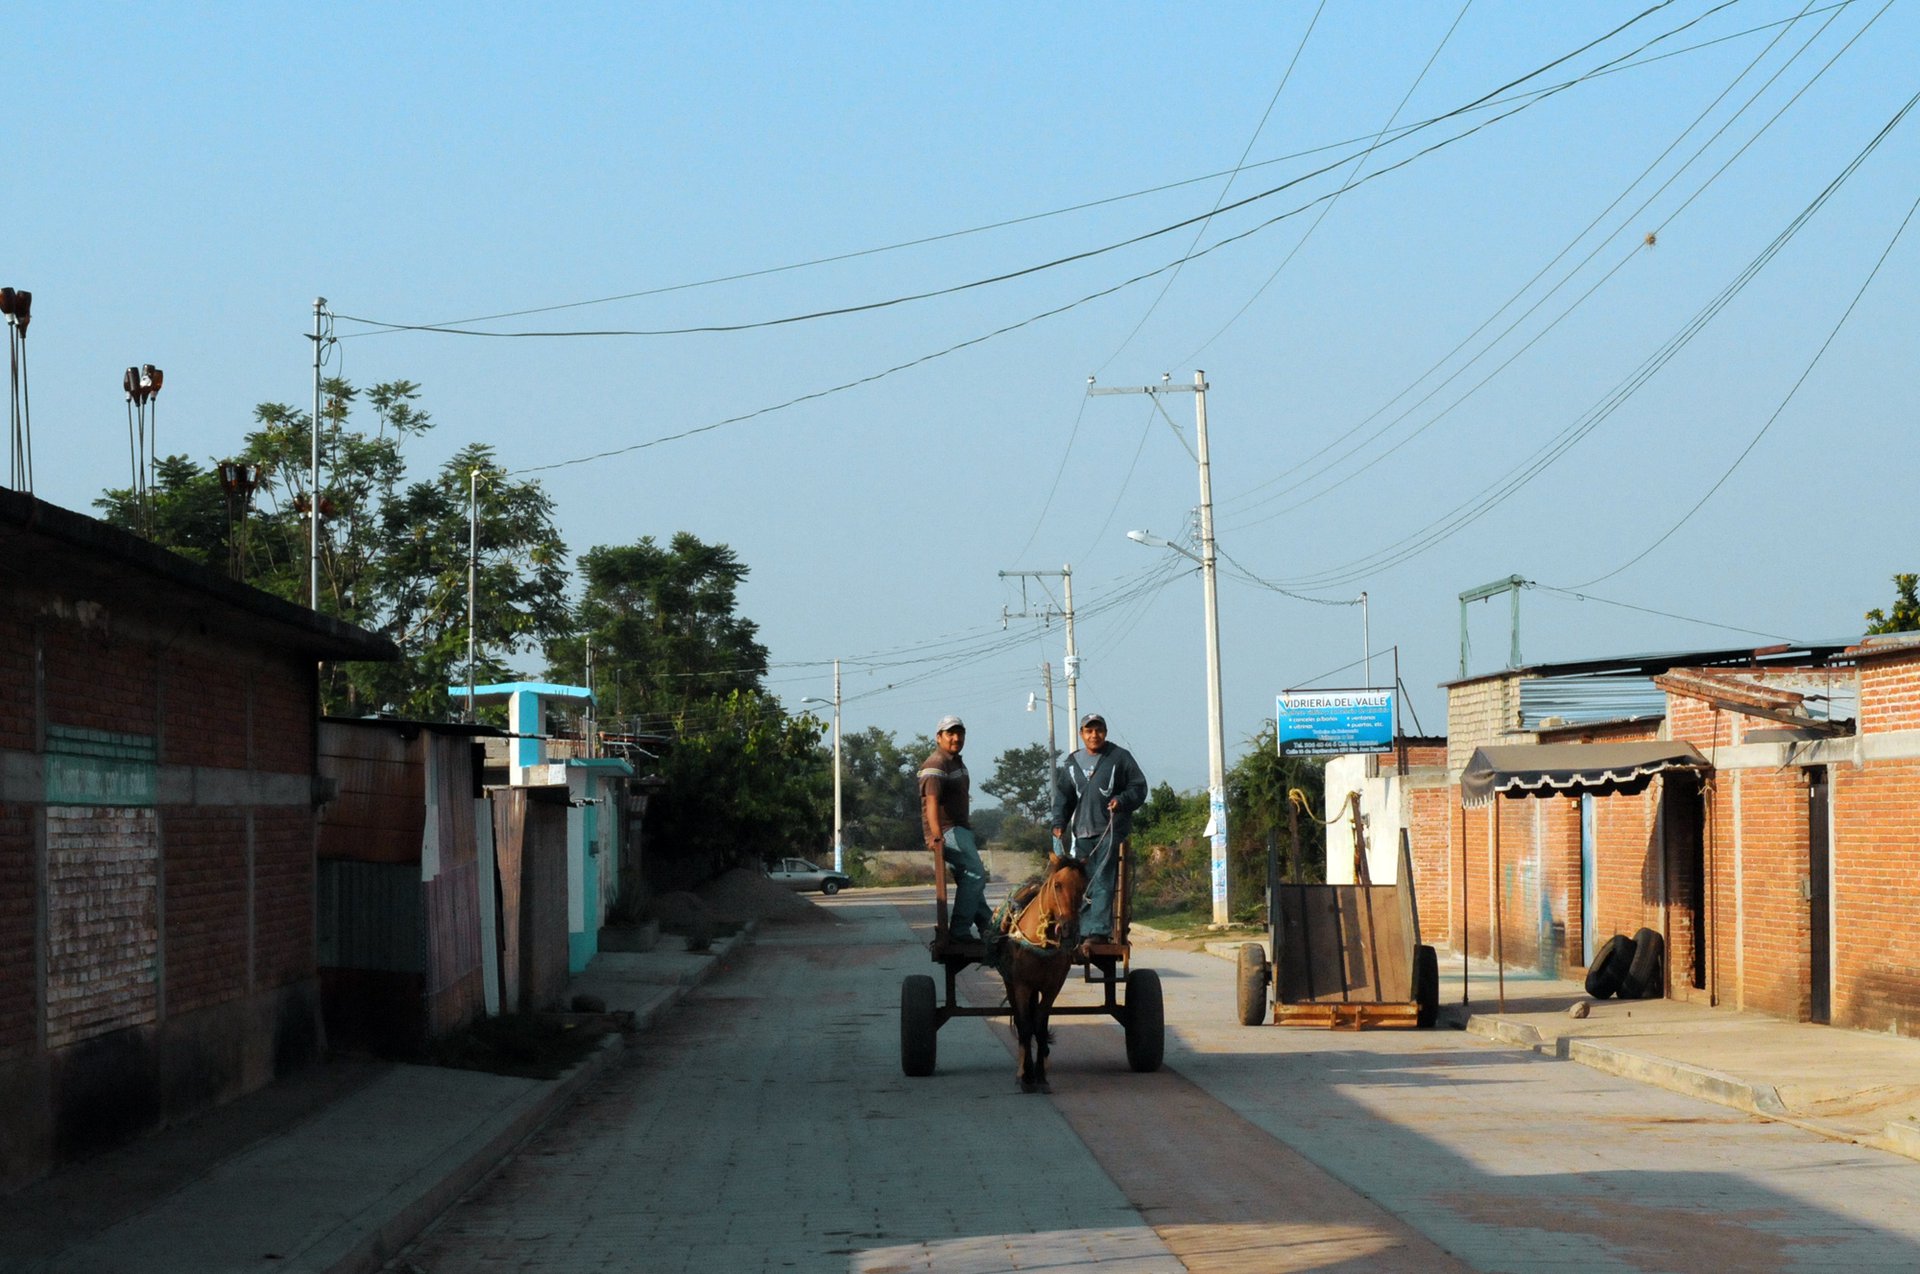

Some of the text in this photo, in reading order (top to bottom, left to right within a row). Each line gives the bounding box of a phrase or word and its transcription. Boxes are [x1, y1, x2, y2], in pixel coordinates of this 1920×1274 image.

[1284, 697, 1386, 708] VIDRIERÍA DEL VALLE
